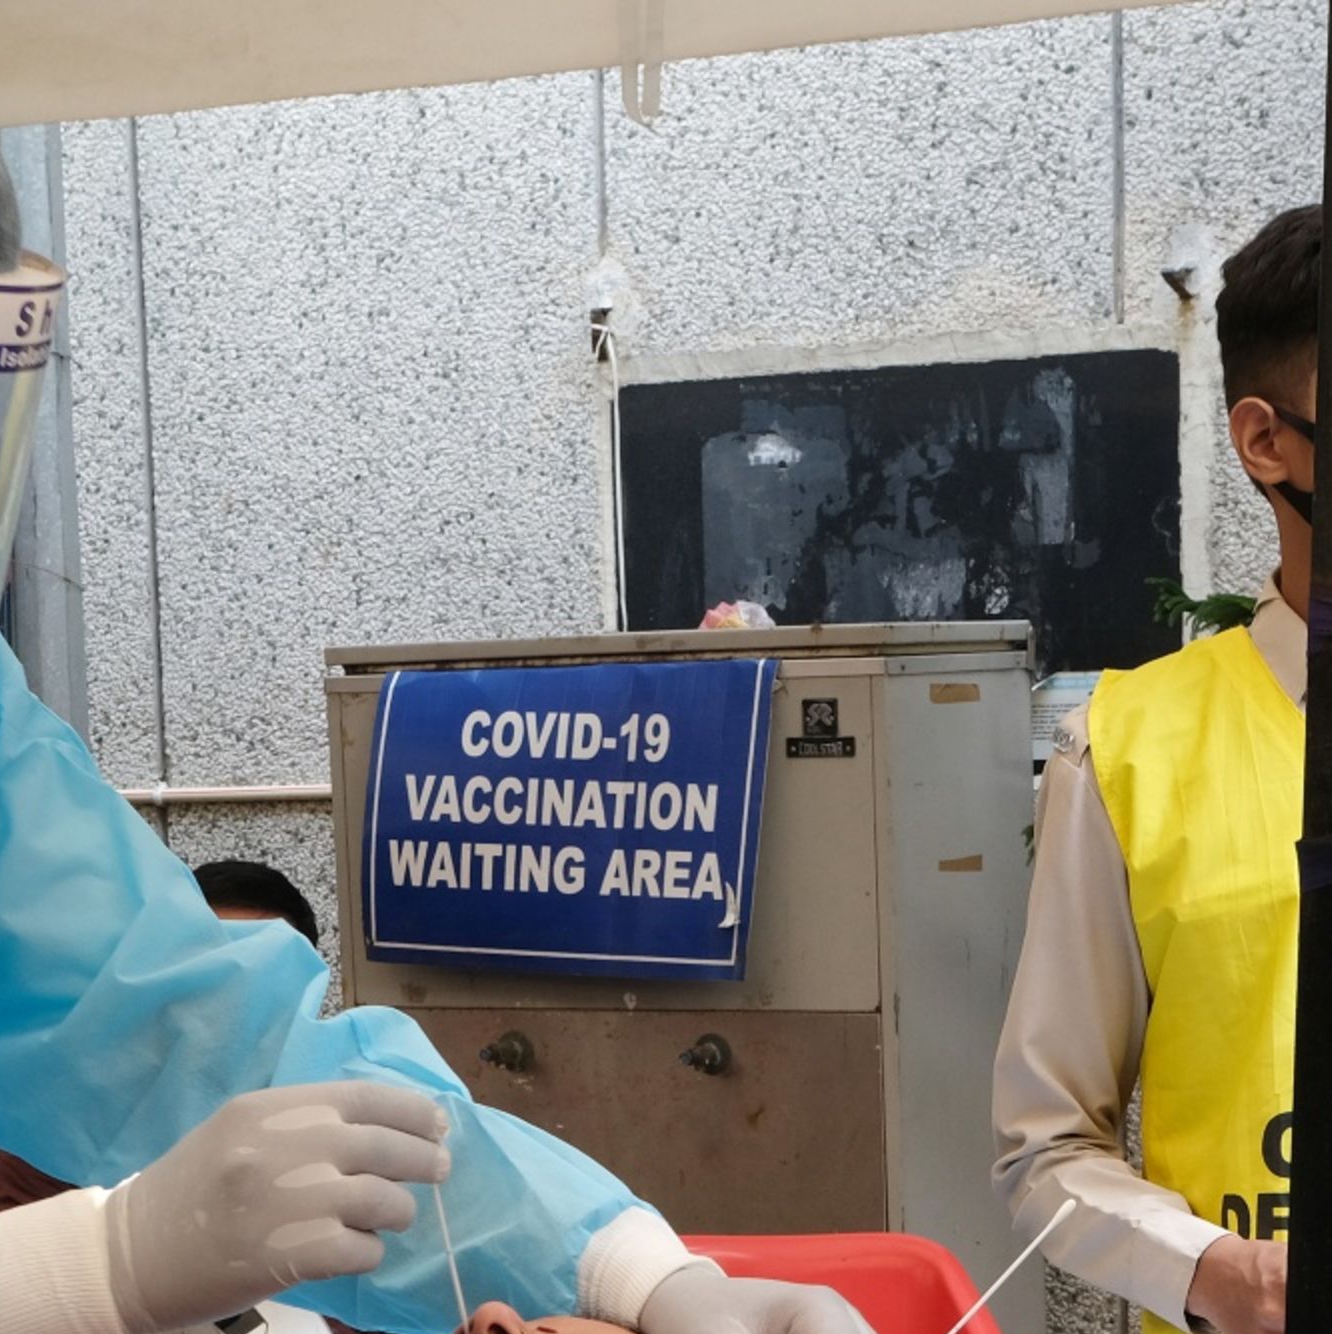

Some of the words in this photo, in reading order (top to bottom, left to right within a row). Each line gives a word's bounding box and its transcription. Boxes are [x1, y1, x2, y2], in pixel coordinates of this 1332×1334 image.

[461, 710, 671, 763] COVID-19
[405, 774, 719, 832] VACCINATION
[389, 839, 585, 895] WAITING
[599, 849, 724, 900] AREA
